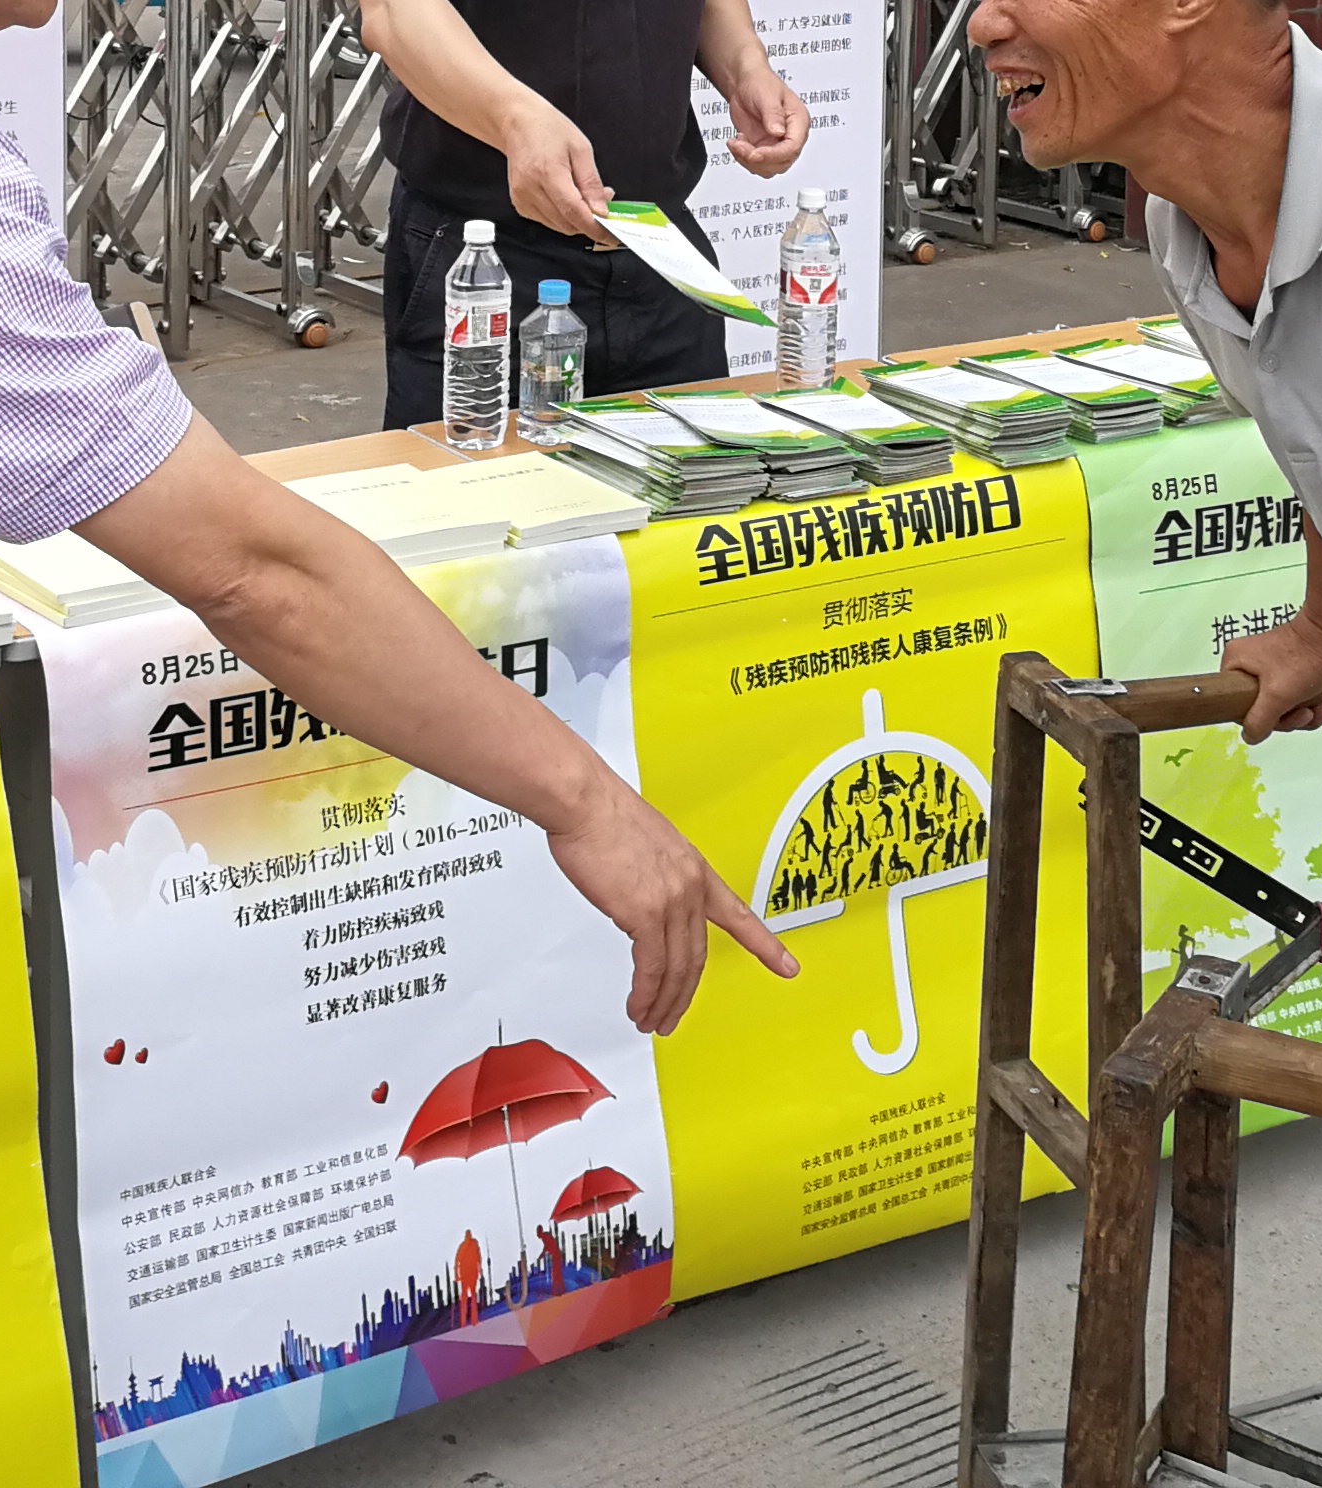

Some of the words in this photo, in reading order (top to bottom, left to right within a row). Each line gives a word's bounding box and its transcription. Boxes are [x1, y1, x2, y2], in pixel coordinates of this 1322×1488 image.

[754, 12, 852, 33] 练、扩大学习就业能
[1151, 473, 1219, 502] 8月25日
[694, 474, 1022, 586] 全国残疾预防日
[821, 587, 914, 630] 贯彻落实
[141, 647, 240, 687] 8月25日
[729, 612, 1009, 696] 《残疾预防和残疾人康复条例》
[320, 792, 408, 833] 贯彻落实
[233, 849, 504, 928] 有效控制出生缺陷和发育障碍致残
[302, 899, 445, 951] 着力防控疾病致残
[304, 935, 447, 990] 努力减少伤害致残
[305, 972, 448, 1026] 显著改善康复服务
[120, 1165, 217, 1202] 中国残疾人联合会
[121, 1199, 187, 1229] 中央宣传部
[192, 1180, 255, 1209] 中央网信办
[261, 1168, 298, 1190] 教育部
[303, 1143, 389, 1177] 工业和信息化部
[124, 1233, 163, 1256] 公安部
[168, 1220, 206, 1244] 民政部
[212, 1187, 325, 1231] 人力资源社会保障部
[330, 1168, 392, 1196] 环境保护部
[126, 1252, 190, 1283] 交通运输部
[196, 1227, 277, 1263] 国家卫生计生委
[282, 1193, 394, 1238] 国家新闻出版广电总局
[128, 1270, 223, 1310] 国家安全监管总局
[229, 1252, 286, 1280] 全国总工会
[291, 1235, 348, 1261] 共青团中央
[353, 1219, 398, 1244] 全国妇联
